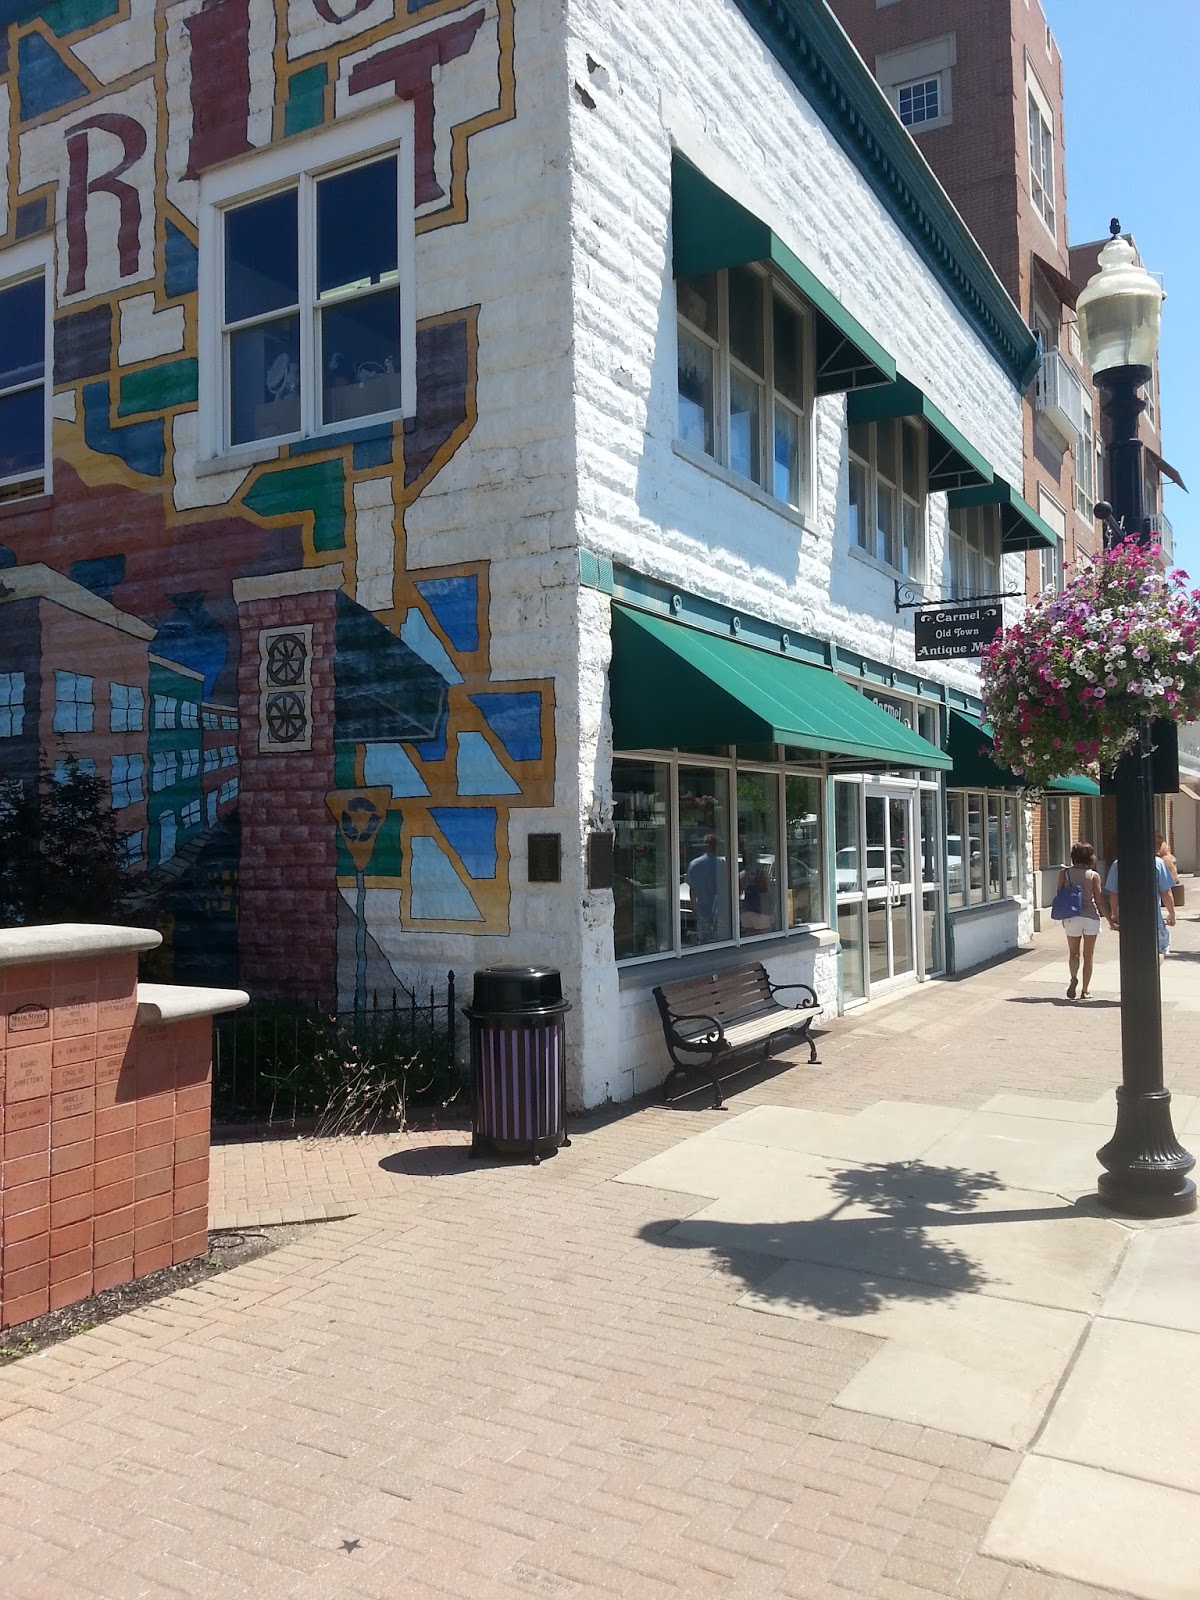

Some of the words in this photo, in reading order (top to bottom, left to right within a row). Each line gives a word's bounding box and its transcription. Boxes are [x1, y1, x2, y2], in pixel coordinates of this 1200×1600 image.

[936, 608, 980, 623] Carmel
[935, 628, 951, 639] Old
[954, 627, 979, 638] Town
[917, 644, 967, 657] Antique
[12, 1014, 27, 1022] Main
[27, 1012, 46, 1020] Street
[19, 1060, 39, 1069] BOARD
[14, 1075, 44, 1088] DIRECTORS
